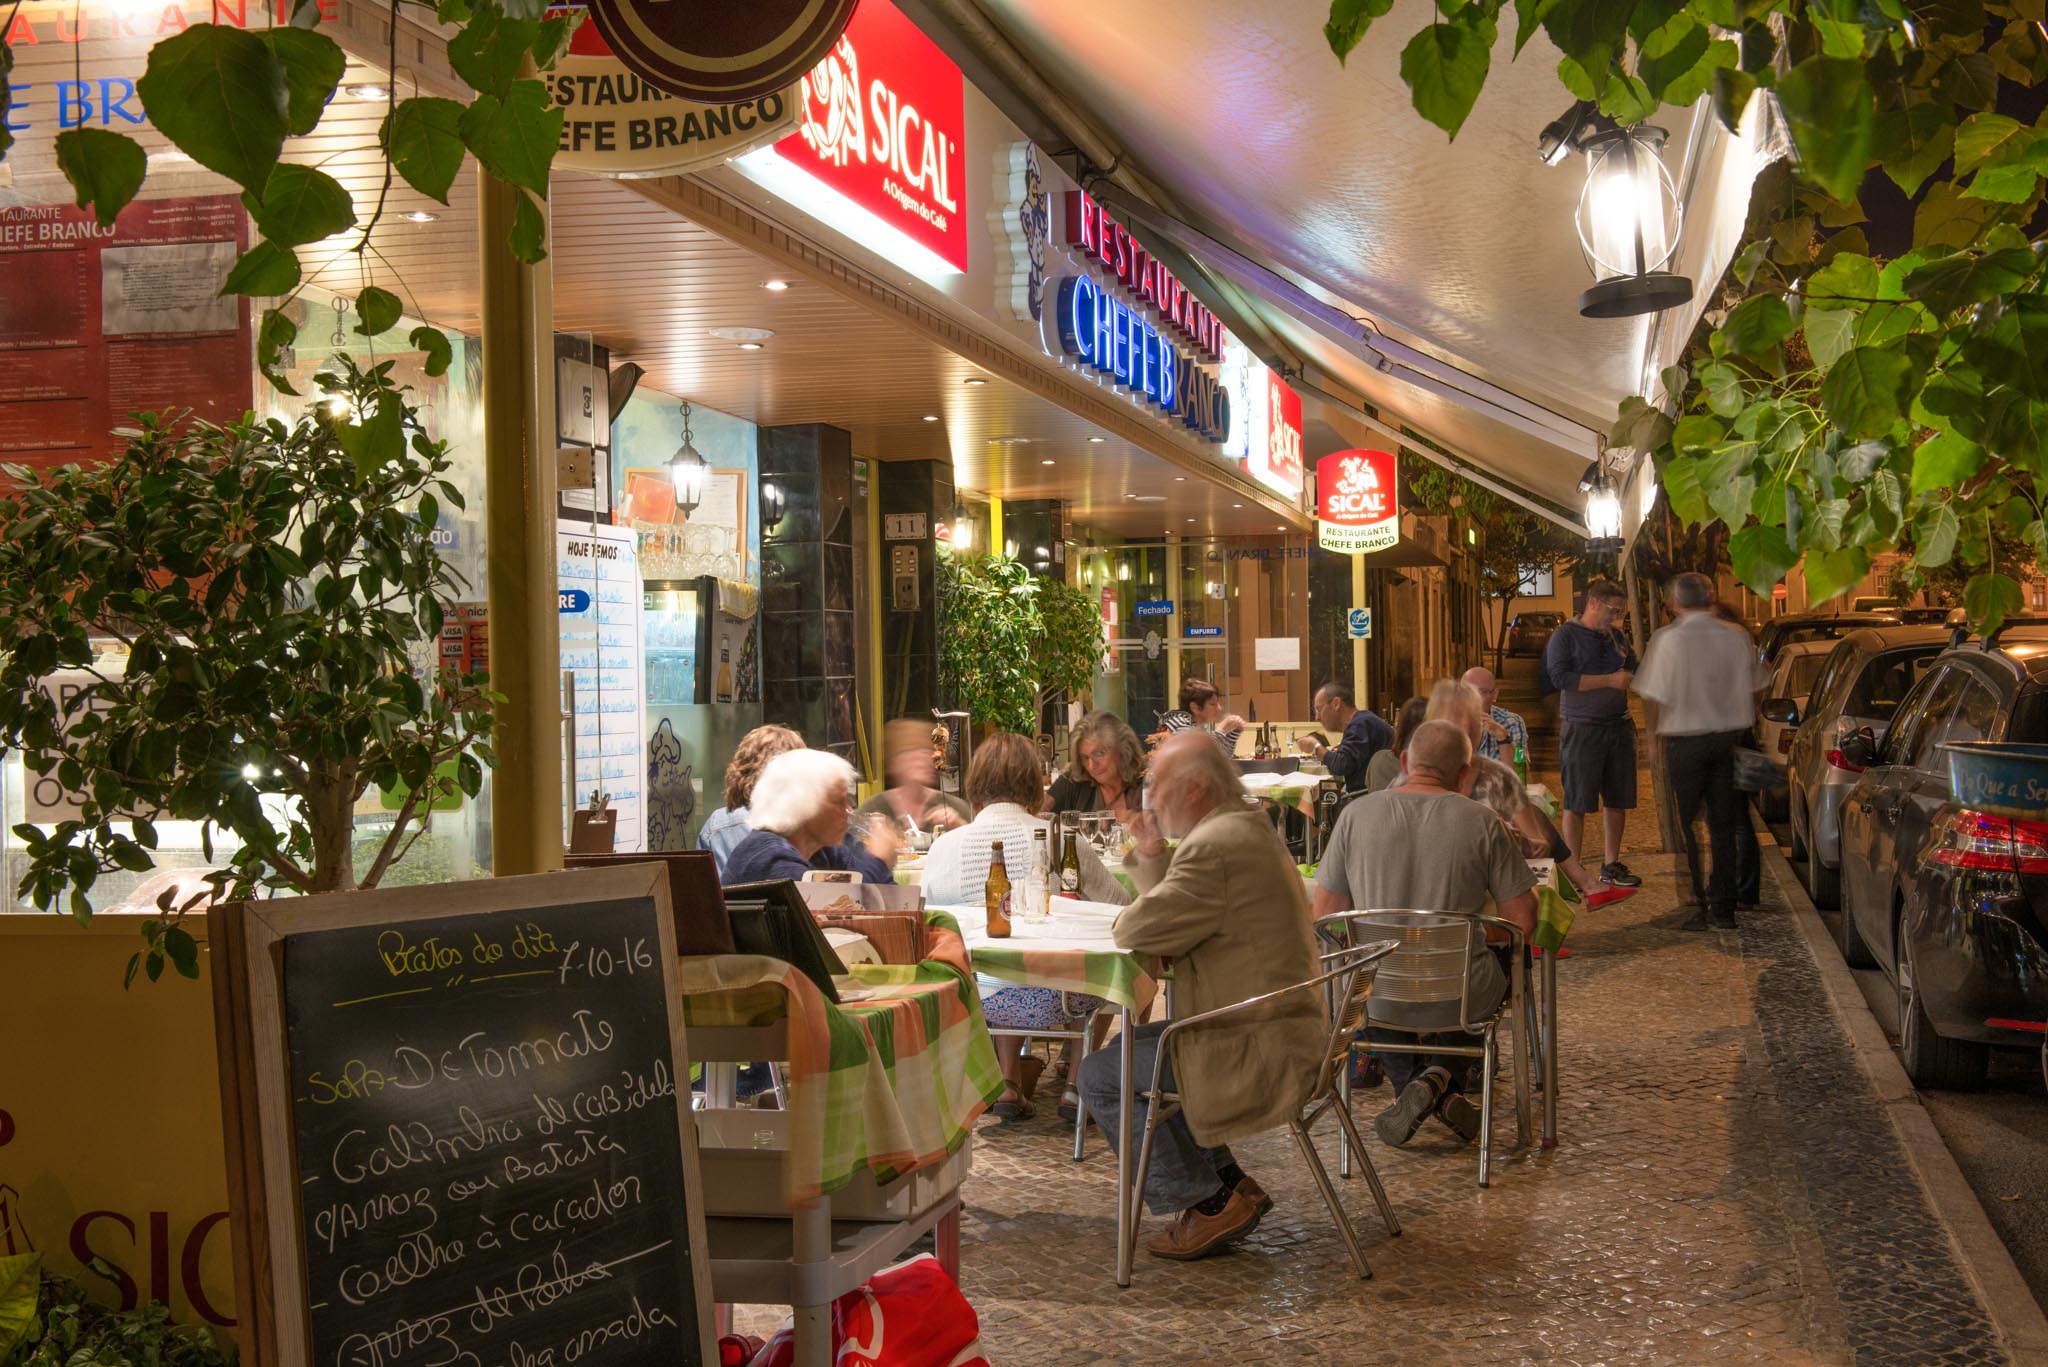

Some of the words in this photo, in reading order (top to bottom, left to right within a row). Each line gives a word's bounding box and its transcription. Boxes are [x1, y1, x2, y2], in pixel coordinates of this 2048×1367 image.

[546, 74, 672, 106] STAUR
[629, 92, 784, 150] BRANCO
[870, 79, 957, 214] SICAL
[890, 184, 920, 214] Origem
[1076, 189, 1227, 363] RESTAURANTE
[1070, 273, 1157, 396] CHEFE
[1158, 335, 1230, 444] BRANCO
[1329, 494, 1385, 513] SICAL
[896, 519, 915, 533] 11
[1326, 526, 1391, 537] RESTAURANTE
[567, 541, 589, 557] HOJE
[591, 543, 619, 560] TEMOS
[1321, 538, 1352, 549] CHEFE
[1355, 536, 1395, 549] BRANCO
[1138, 605, 1171, 615] Fechado
[444, 627, 462, 635] VISA
[445, 645, 462, 653] VISA
